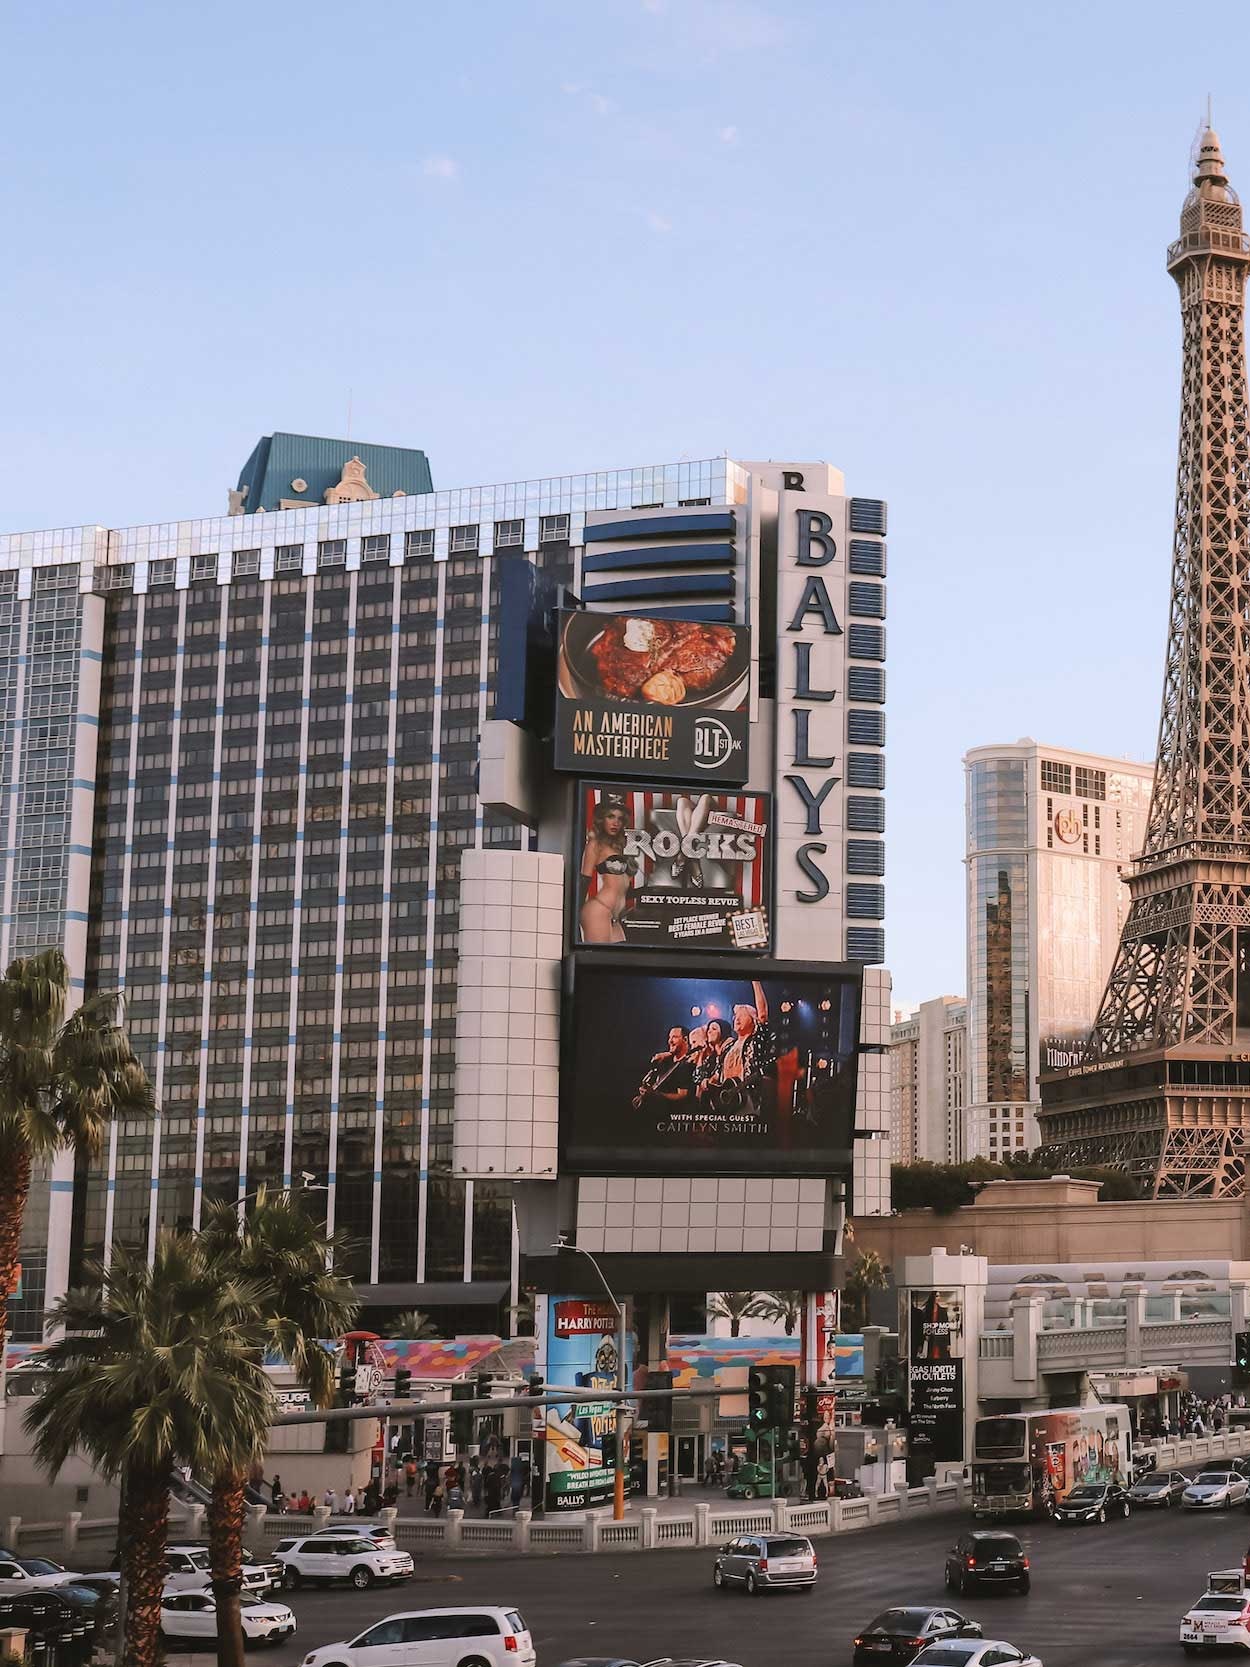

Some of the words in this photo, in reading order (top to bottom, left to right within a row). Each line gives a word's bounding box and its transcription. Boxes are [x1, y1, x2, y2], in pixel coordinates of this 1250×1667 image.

[785, 508, 844, 904] BALLYS
[573, 710, 593, 732] AN
[600, 711, 673, 738] AMERICAN
[573, 733, 670, 761] MASTERPIECE
[694, 727, 722, 757] BLT
[623, 828, 757, 861] ROCKS
[641, 895, 665, 905] SEXY
[666, 896, 706, 906] TOPLESS
[708, 898, 740, 906] REVUE
[684, 921, 707, 931] FEMALE
[735, 917, 755, 931] BEST
[724, 1123, 768, 1133] SMITH
[558, 1318, 593, 1329] HARRY
[593, 1318, 615, 1329] POTTER
[922, 1372, 956, 1380] OUTLETS
[557, 1495, 585, 1505] BALLYS
